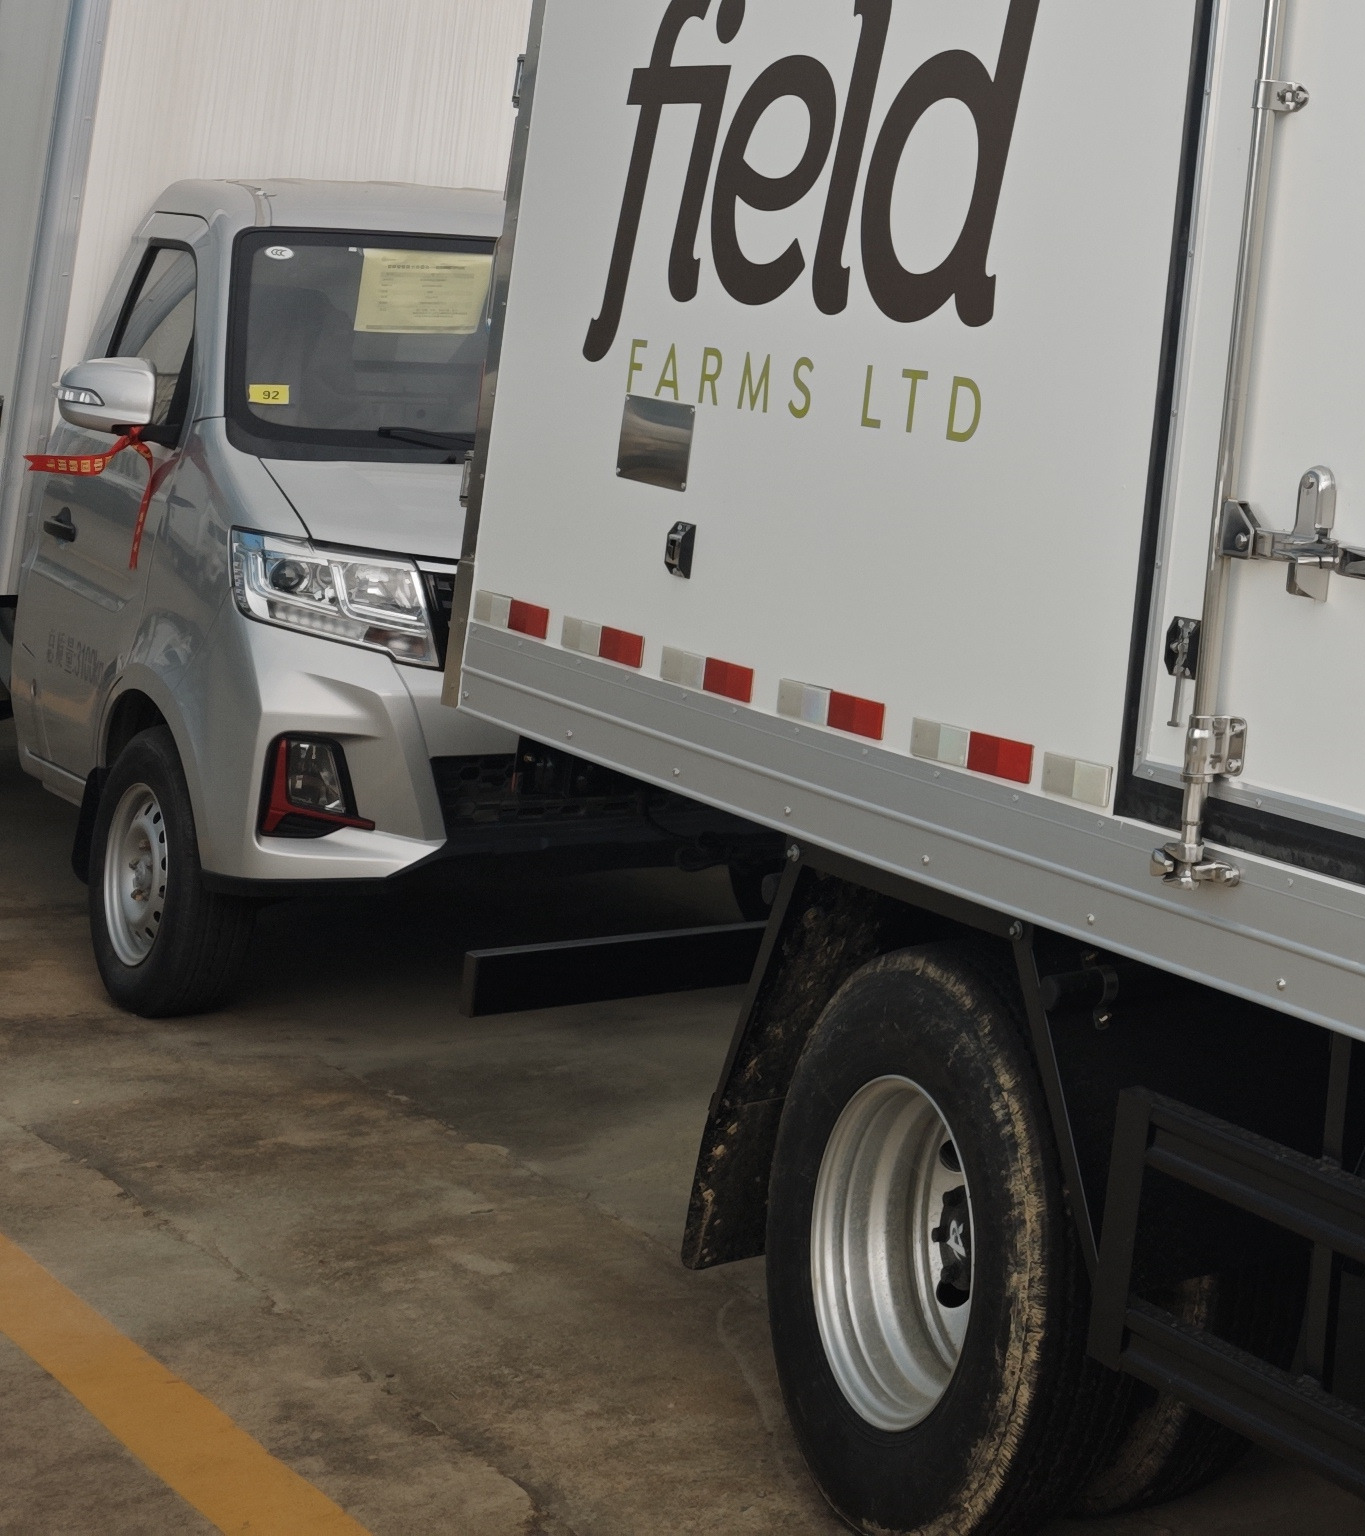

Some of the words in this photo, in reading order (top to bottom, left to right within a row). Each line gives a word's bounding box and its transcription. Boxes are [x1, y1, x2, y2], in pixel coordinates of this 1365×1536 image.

[262, 390, 280, 400] 92
[626, 338, 814, 419] FARMS
[860, 364, 982, 443] LTD
